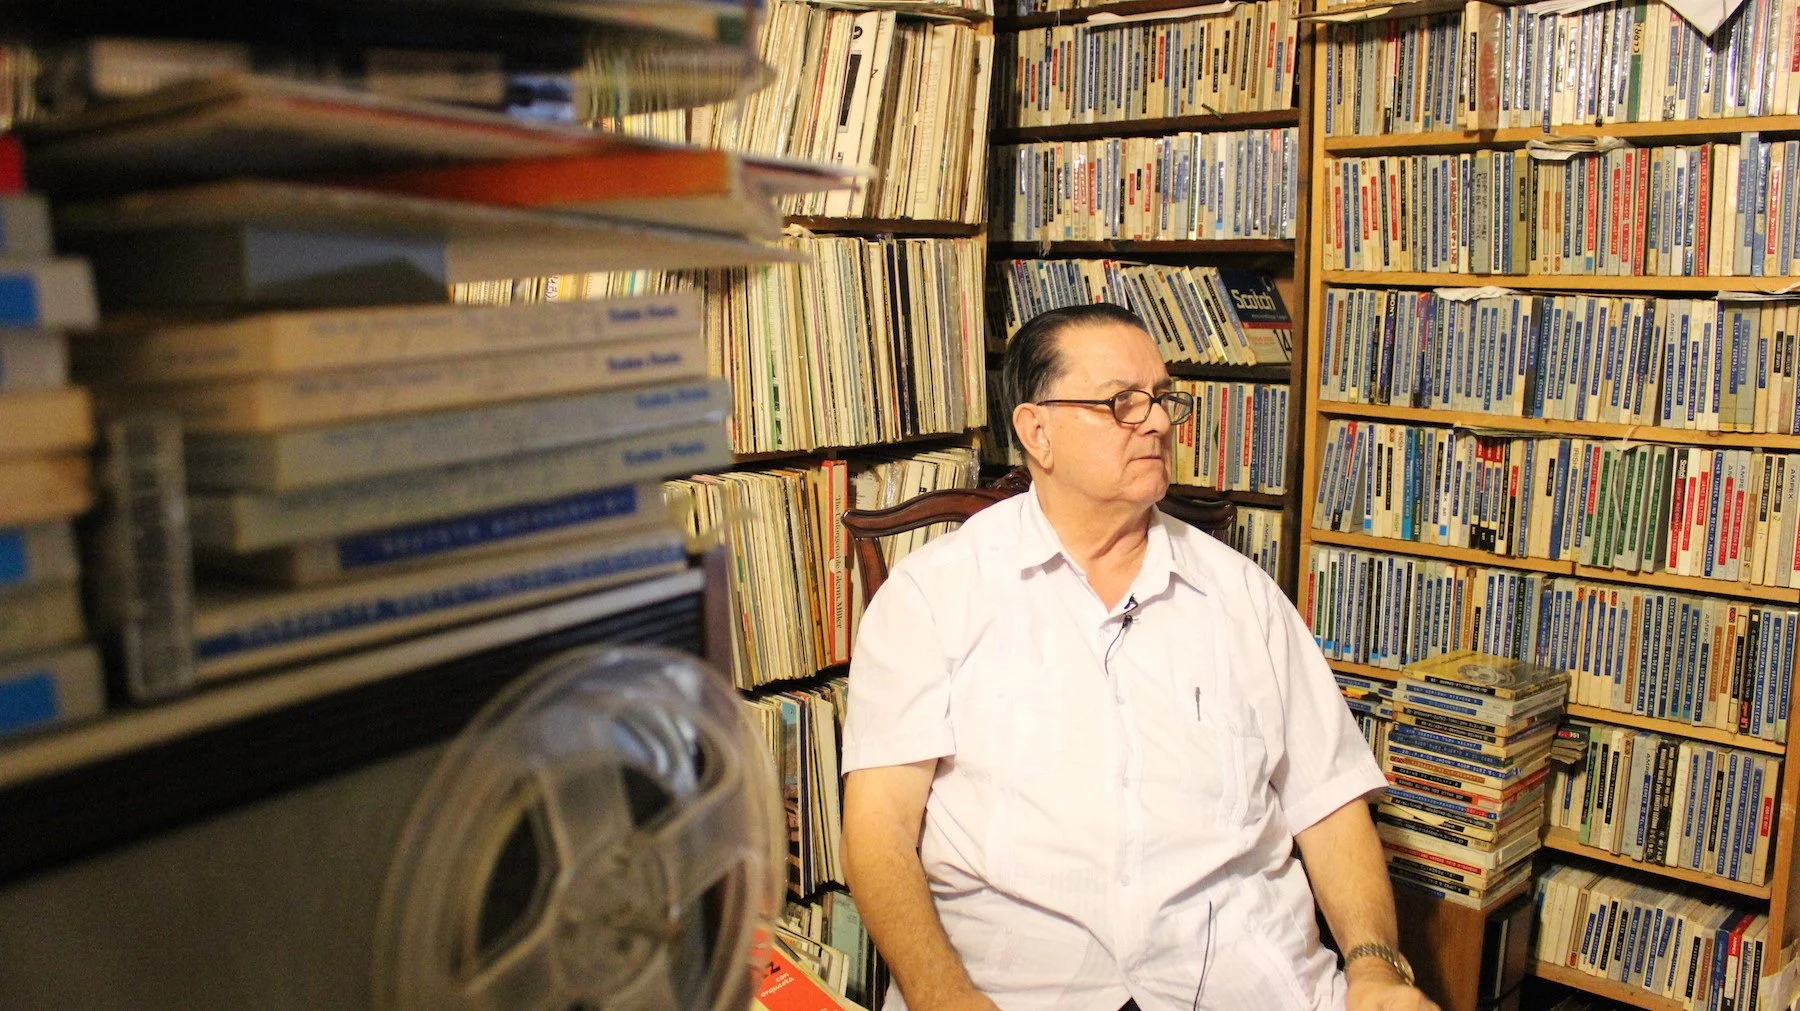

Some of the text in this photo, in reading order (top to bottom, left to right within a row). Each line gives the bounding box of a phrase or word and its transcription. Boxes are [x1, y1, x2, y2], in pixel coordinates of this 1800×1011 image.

[1230, 289, 1276, 310] Scotch
[760, 976, 794, 998] orquesta
[776, 972, 790, 982] con
